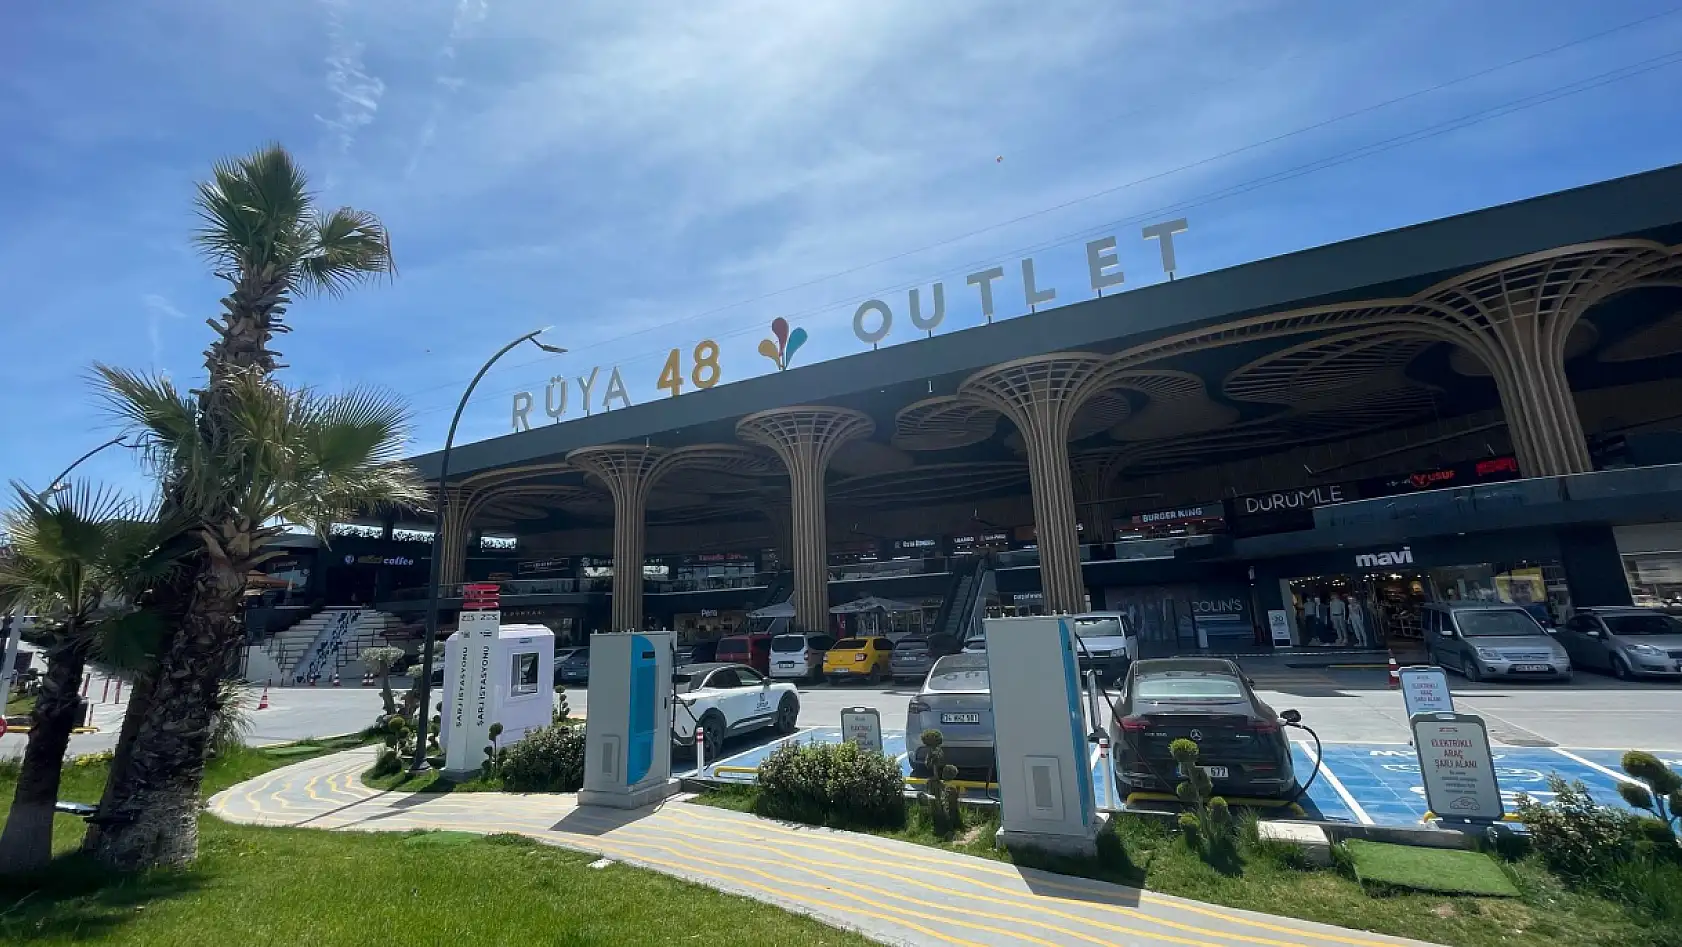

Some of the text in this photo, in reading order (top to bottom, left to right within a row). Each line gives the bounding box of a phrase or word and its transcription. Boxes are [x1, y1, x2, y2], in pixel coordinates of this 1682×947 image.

[511, 217, 1189, 431] RÜYA 48 OUTLET
[1142, 507, 1203, 523] BURGER KING
[1355, 546, 1414, 567] mavi
[1191, 598, 1244, 613] COLIN'S
